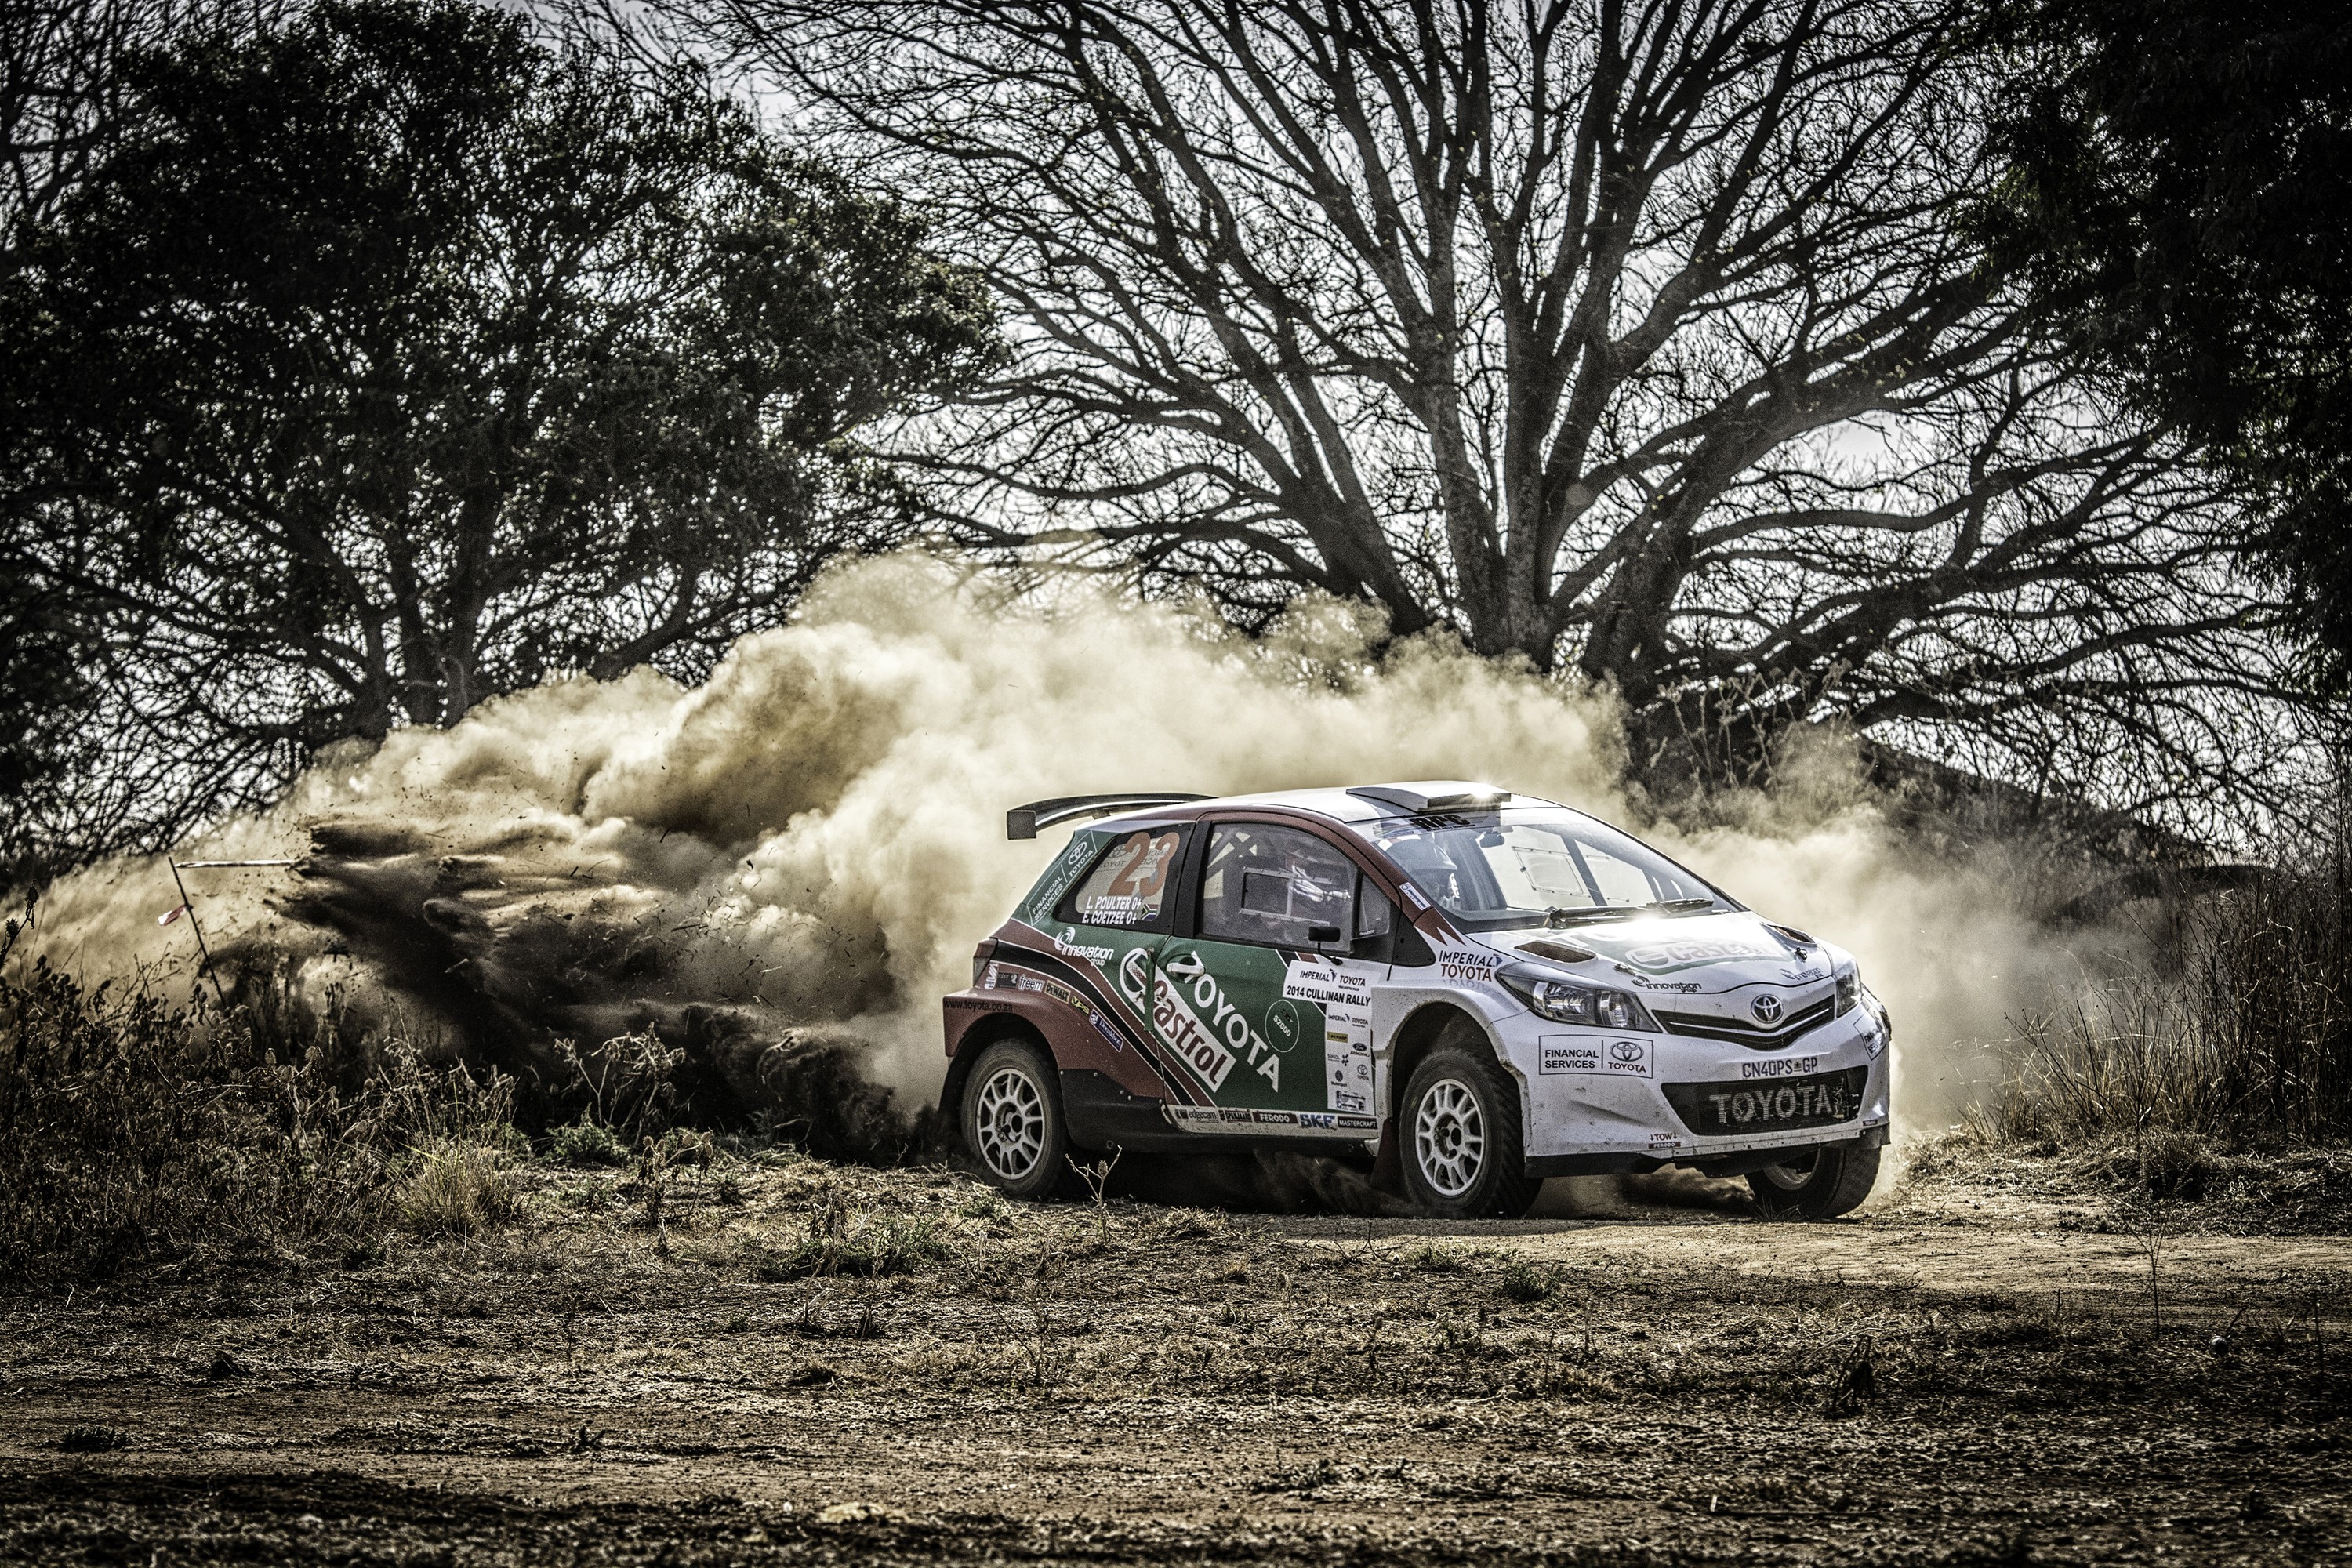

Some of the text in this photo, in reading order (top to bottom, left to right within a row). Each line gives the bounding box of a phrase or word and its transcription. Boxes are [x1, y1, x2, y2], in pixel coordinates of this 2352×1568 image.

[1069, 850, 1094, 877] TOYOTA
[1106, 832, 1180, 897] 23
[1032, 876, 1063, 914] FINANCIAL
[1034, 884, 1064, 921] SERVICES
[1086, 895, 1093, 910] L.
[1096, 896, 1131, 910] POULTER
[1082, 910, 1090, 924] E.
[1092, 911, 1125, 924] COETZEE
[1062, 945, 1114, 960] innovation
[1439, 950, 1494, 967] IMPERIAL
[1090, 958, 1105, 967] group
[1300, 970, 1366, 987] IMPERIAL TOYOTA
[1441, 964, 1492, 982] TOYOTA
[1019, 975, 1044, 990] freem
[1287, 985, 1305, 997] 2014
[1306, 988, 1345, 1004] CULLINAN
[1346, 993, 1371, 1007] RALLY
[944, 1000, 1013, 1012] www.toyota.co.za
[1071, 996, 1090, 1014] VPS
[1273, 1014, 1291, 1037] S2000
[1544, 1049, 1599, 1058] FINANCIAL
[1544, 1060, 1595, 1069] SERVICES
[1608, 1062, 1646, 1073] TOYOTA
[1802, 1058, 1818, 1073] GP
[1709, 1083, 1833, 1124] TOYOTA
[1189, 1109, 1218, 1121] edgecam
[1259, 1113, 1290, 1123] FERODO
[1299, 1113, 1335, 1129] SKF
[1338, 1120, 1377, 1128] MASTERCRAFT
